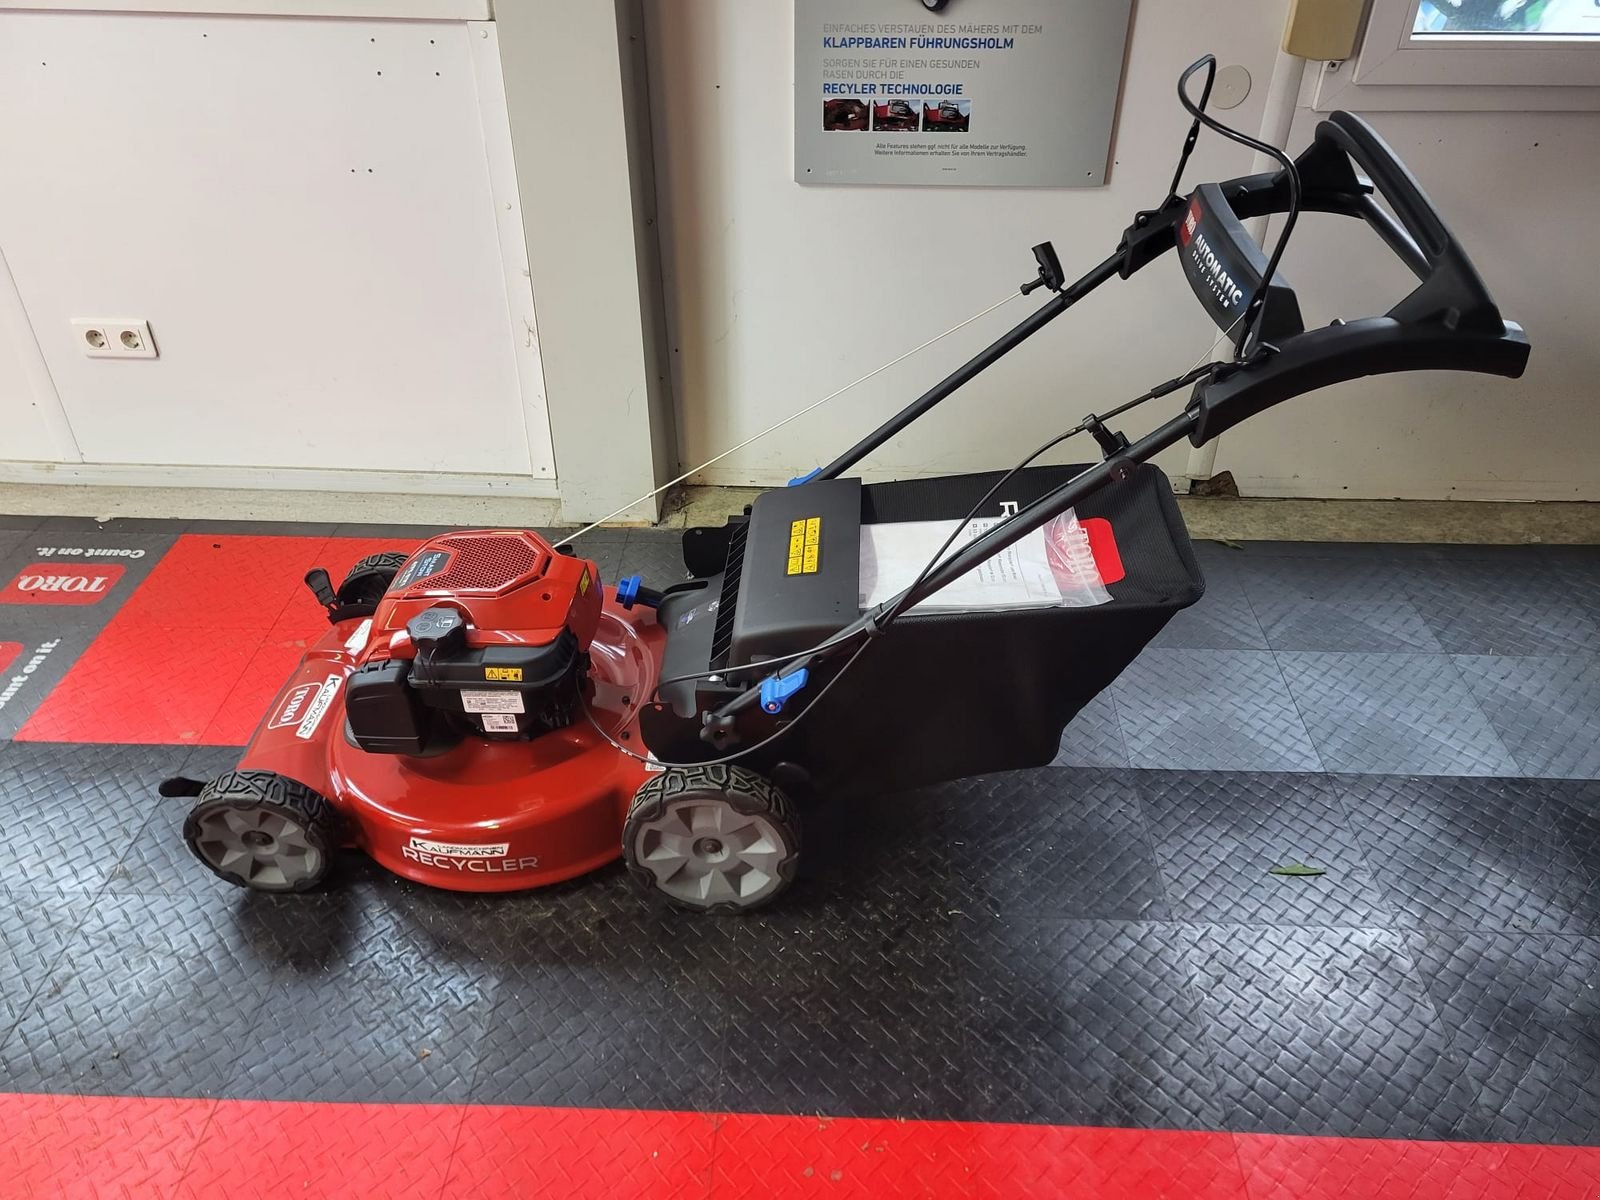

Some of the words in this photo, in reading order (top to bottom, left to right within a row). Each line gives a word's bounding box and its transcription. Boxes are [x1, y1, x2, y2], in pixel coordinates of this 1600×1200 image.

[823, 23, 876, 34] EINFACHES
[878, 24, 934, 34] VERSTAUEN
[937, 24, 956, 34] DES
[958, 23, 1000, 34] MÄHERS
[1002, 25, 1019, 34] MIT
[1021, 25, 1043, 34] DEM
[823, 37, 906, 49] KLAPPBAREN
[909, 34, 1014, 49] FÜHRUNGSHOLM
[823, 58, 860, 68] SORGEN
[862, 58, 877, 68] SIE
[879, 57, 898, 68] FÜR
[900, 59, 927, 69] EINEN
[929, 59, 980, 69] GESUNDEN
[823, 70, 854, 79] RASEN
[856, 70, 887, 79] DURCH
[889, 70, 904, 79] DIE
[823, 83, 877, 95] RECYLER
[879, 83, 963, 95] TECHNOLOGIE
[1194, 233, 1243, 306] AUTOMATIC
[1192, 251, 1206, 274] DRIVE
[1205, 274, 1231, 309] SYSTEM
[36, 547, 57, 557] it.
[58, 547, 83, 556] on
[85, 548, 146, 559] Count
[17, 575, 109, 592] TORO
[23, 654, 46, 674] on
[280, 686, 311, 724] TORO
[412, 839, 504, 856] KAUFMANN
[401, 846, 539, 872] RECYCLER
